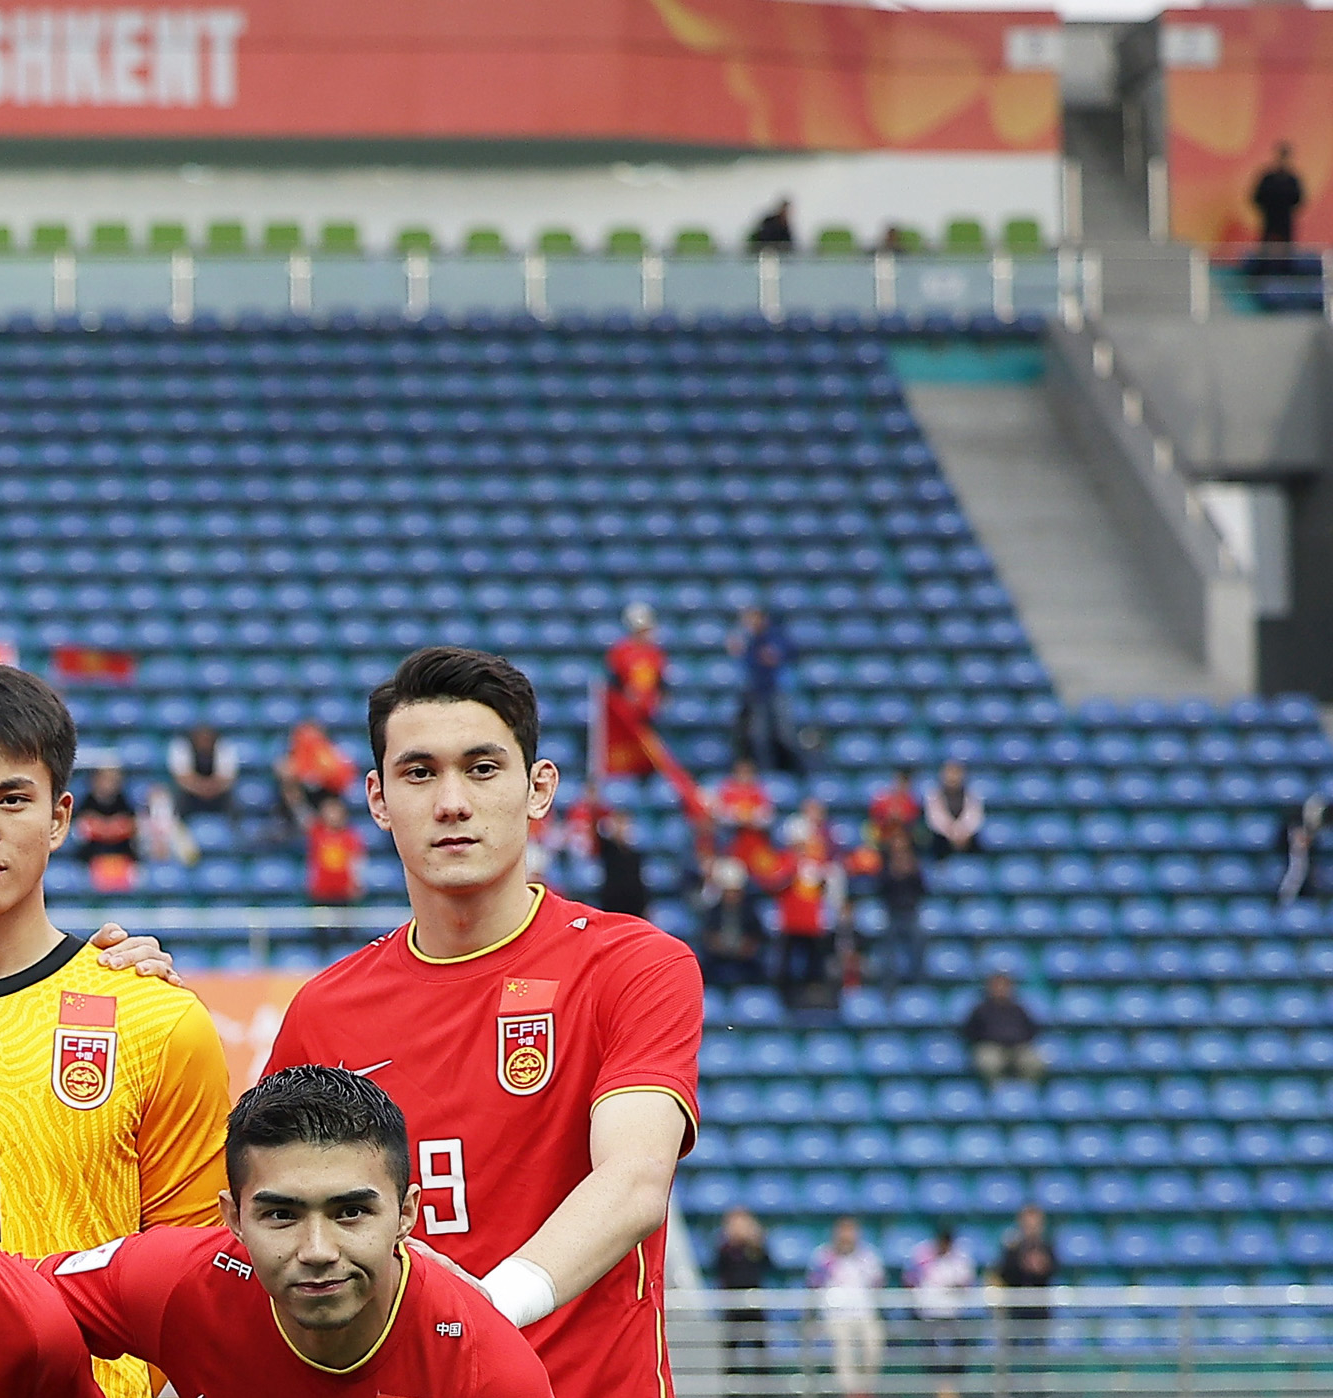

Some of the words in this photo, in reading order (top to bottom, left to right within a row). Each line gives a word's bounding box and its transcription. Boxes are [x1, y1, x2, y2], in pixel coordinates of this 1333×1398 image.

[505, 1021, 547, 1038] CFA
[63, 1037, 107, 1054] CFA
[418, 1137, 470, 1236] 9
[212, 1250, 253, 1281] CFA
[436, 1321, 462, 1337] 中国
